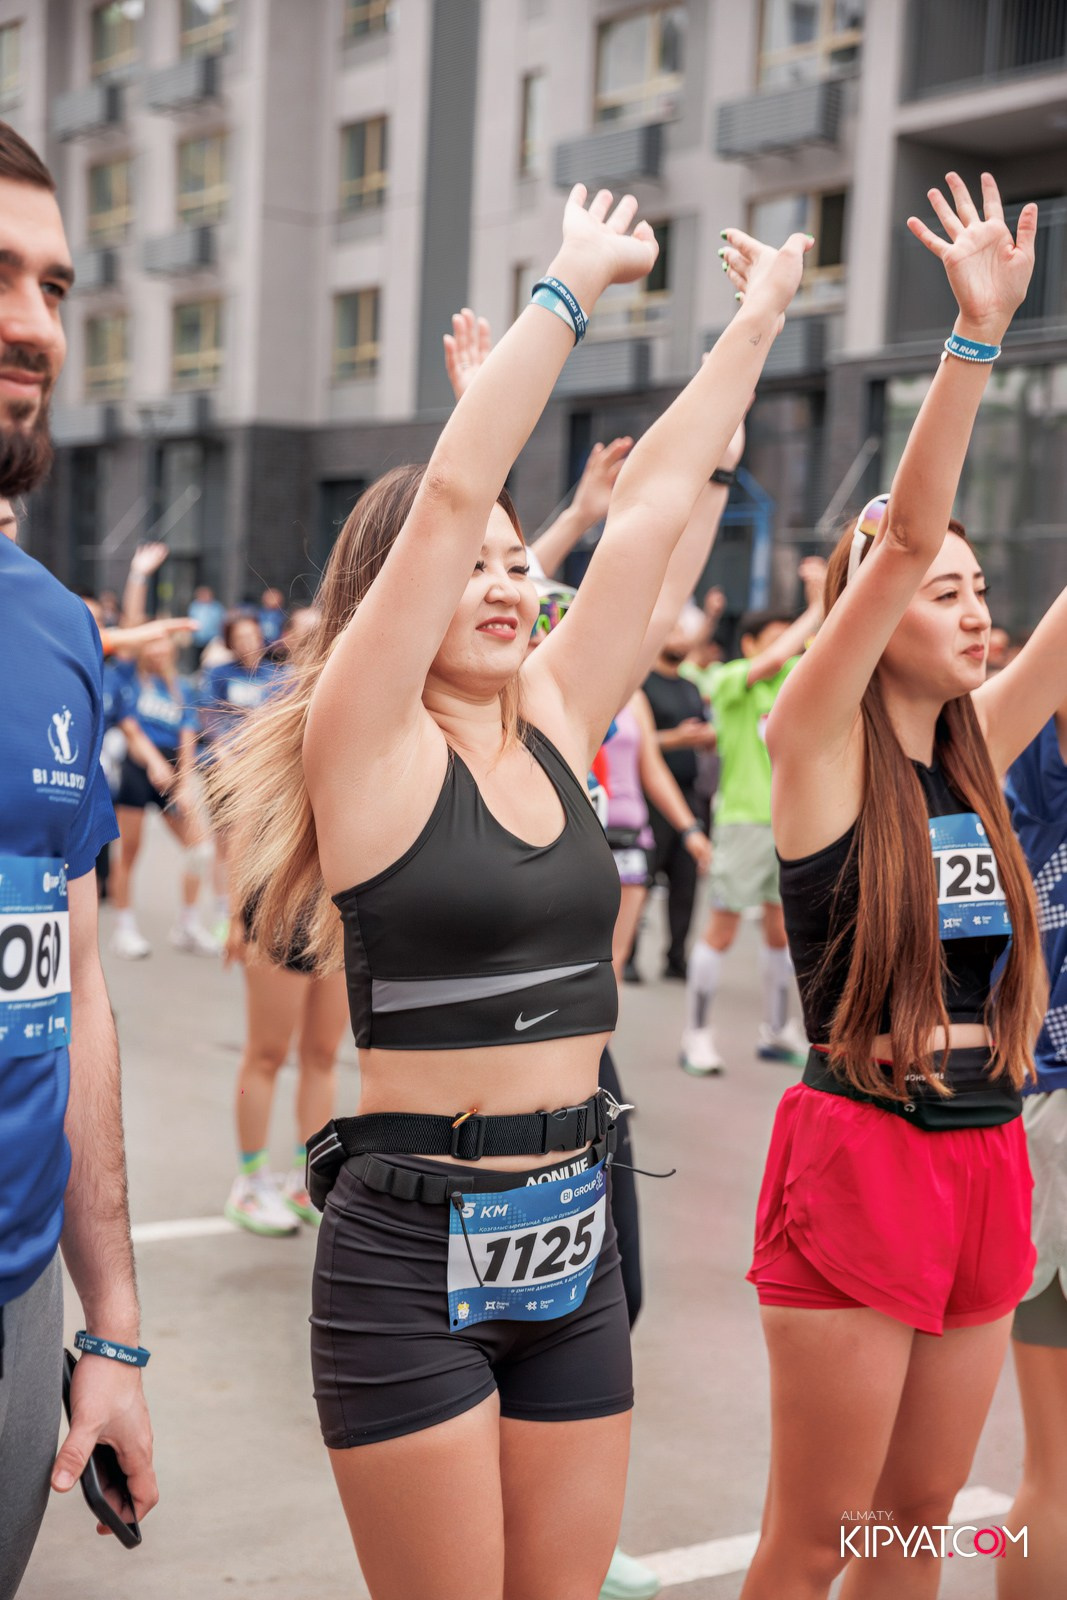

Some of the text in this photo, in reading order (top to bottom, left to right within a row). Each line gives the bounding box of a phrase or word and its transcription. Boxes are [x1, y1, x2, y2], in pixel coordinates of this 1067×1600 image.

[951, 341, 979, 357] BI RUN
[32, 768, 48, 784] BI
[573, 1179, 597, 1197] GROUP
[461, 1203, 509, 1219] 5 KM
[483, 1210, 596, 1282] 1125
[117, 1352, 138, 1363] GROUP
